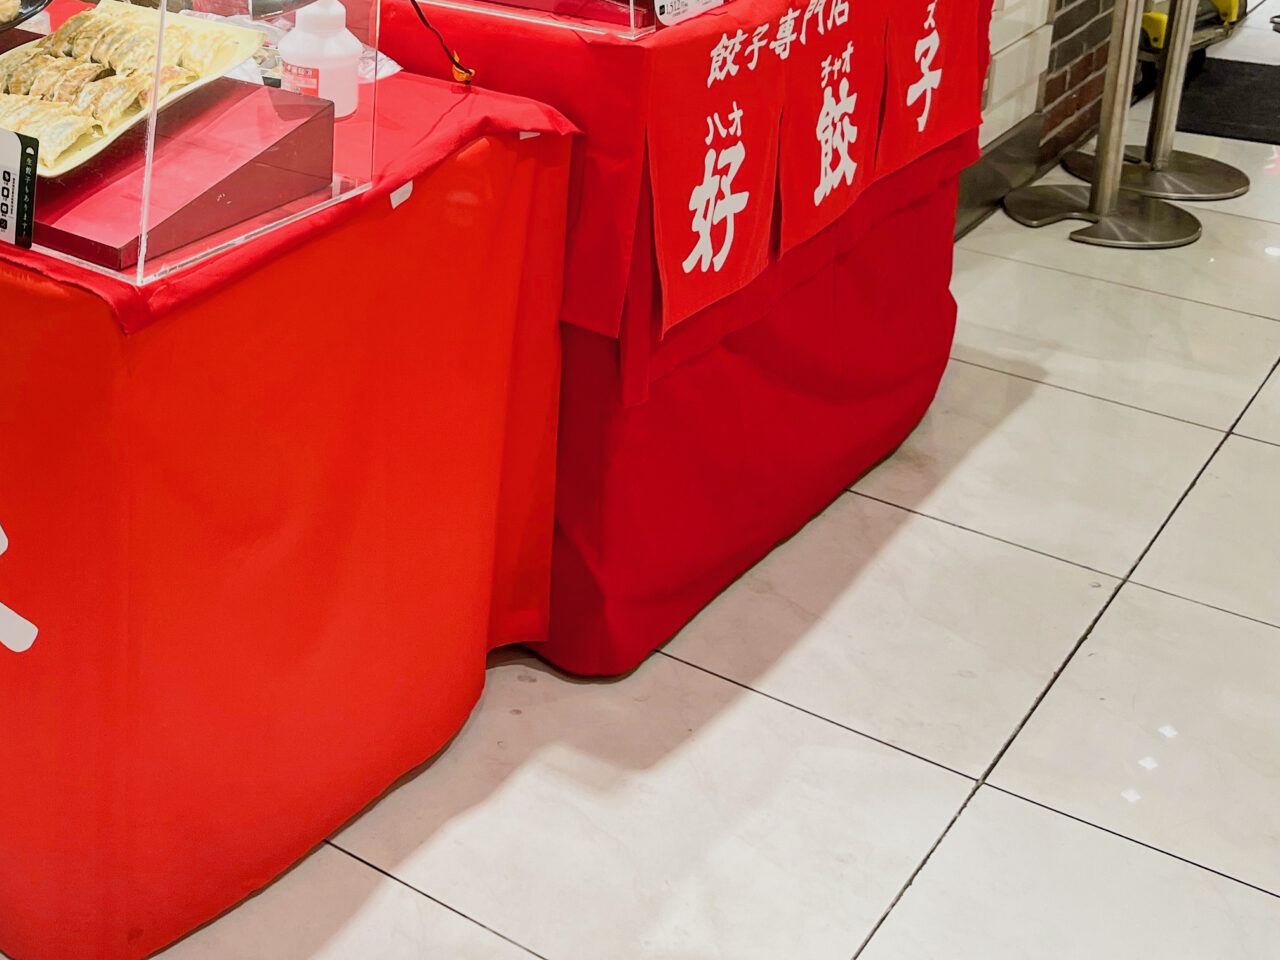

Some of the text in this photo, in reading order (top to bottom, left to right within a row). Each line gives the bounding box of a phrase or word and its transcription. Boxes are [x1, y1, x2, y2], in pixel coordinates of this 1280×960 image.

[705, 101, 744, 145] ハオ
[821, 40, 854, 88] チャオ
